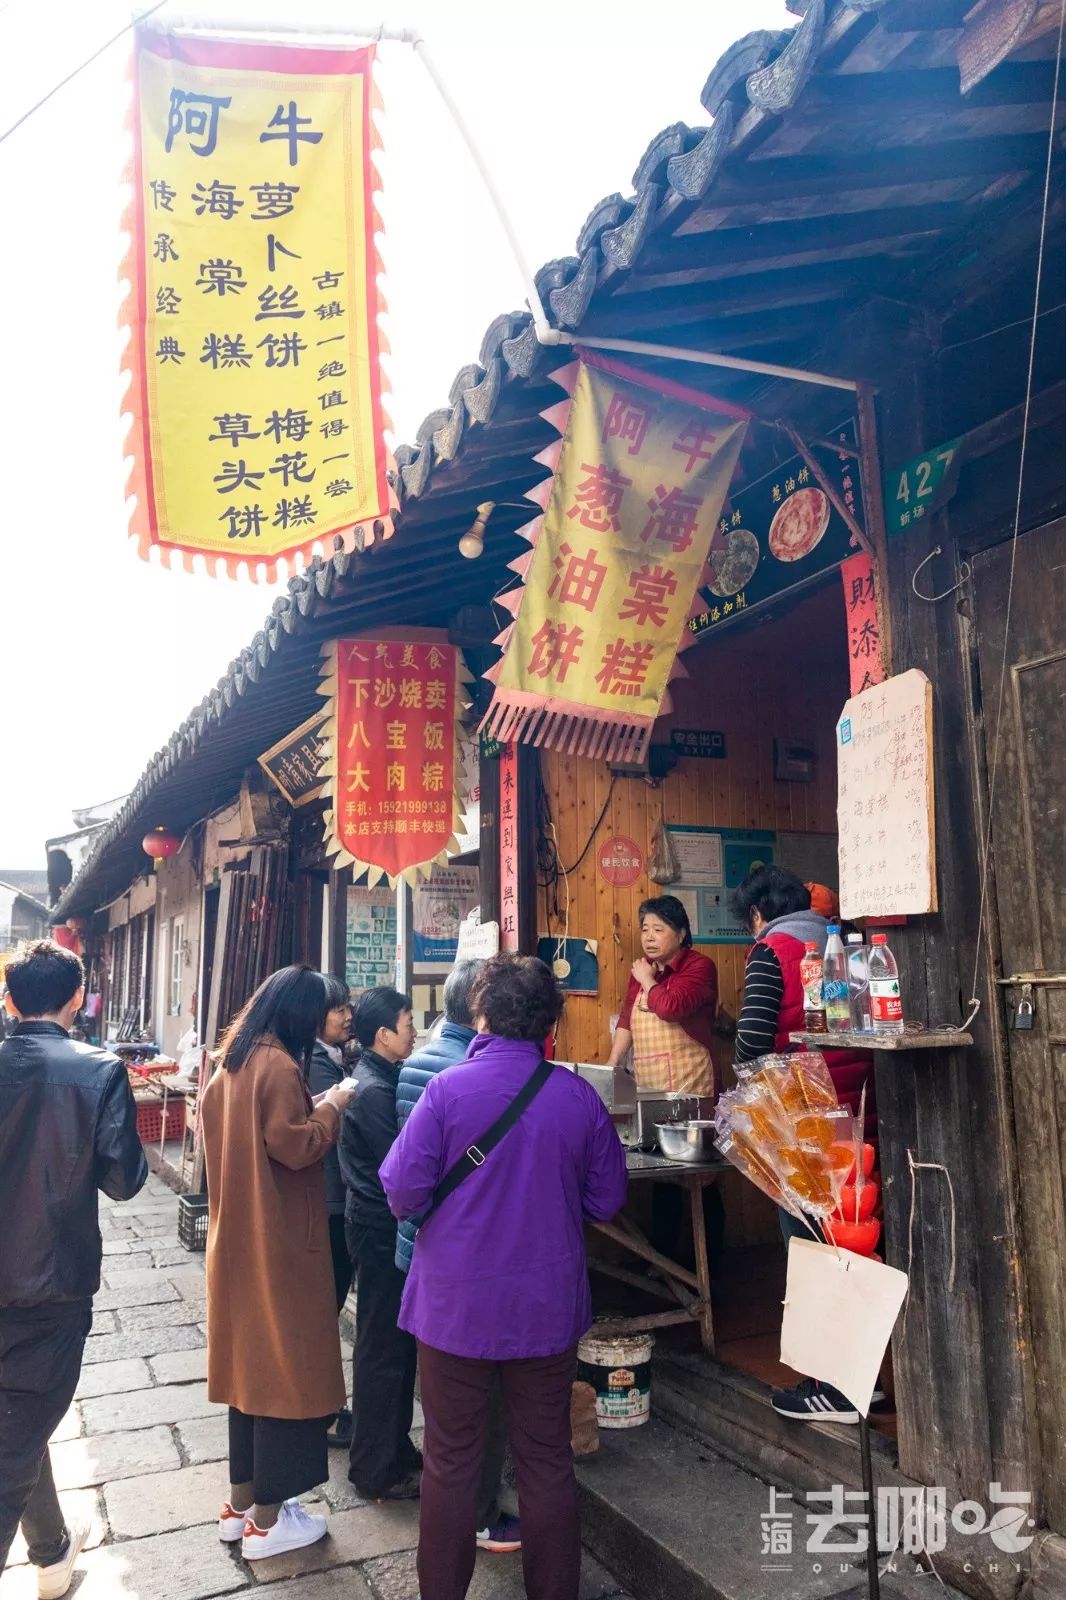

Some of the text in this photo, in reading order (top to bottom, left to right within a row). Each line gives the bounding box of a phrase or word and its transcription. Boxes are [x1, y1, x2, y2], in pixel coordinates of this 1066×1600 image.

[165, 87, 324, 167] 阿牛
[149, 179, 186, 365] 传承经典
[191, 179, 253, 370] 海棠糕
[249, 182, 308, 368] 萝卜丝饼
[311, 271, 354, 498] 古镇一绝值得一尝
[263, 408, 319, 530] 梅花糕
[601, 392, 717, 473] 阿牛
[208, 412, 269, 539] 草头饼
[770, 465, 811, 503] 葱油饼
[527, 463, 633, 683] 葱油饼
[595, 483, 704, 697] 海棠糕
[347, 643, 448, 670] 人气美食
[348, 677, 448, 709] 下沙烧卖
[347, 720, 445, 751] 八宝饭
[673, 732, 723, 746] 安全出口
[346, 761, 445, 793] 大肉粽
[378, 800, 447, 814] 15921999138
[343, 819, 446, 837] 本店支持顺丰快递
[601, 857, 640, 868] 便民饮食
